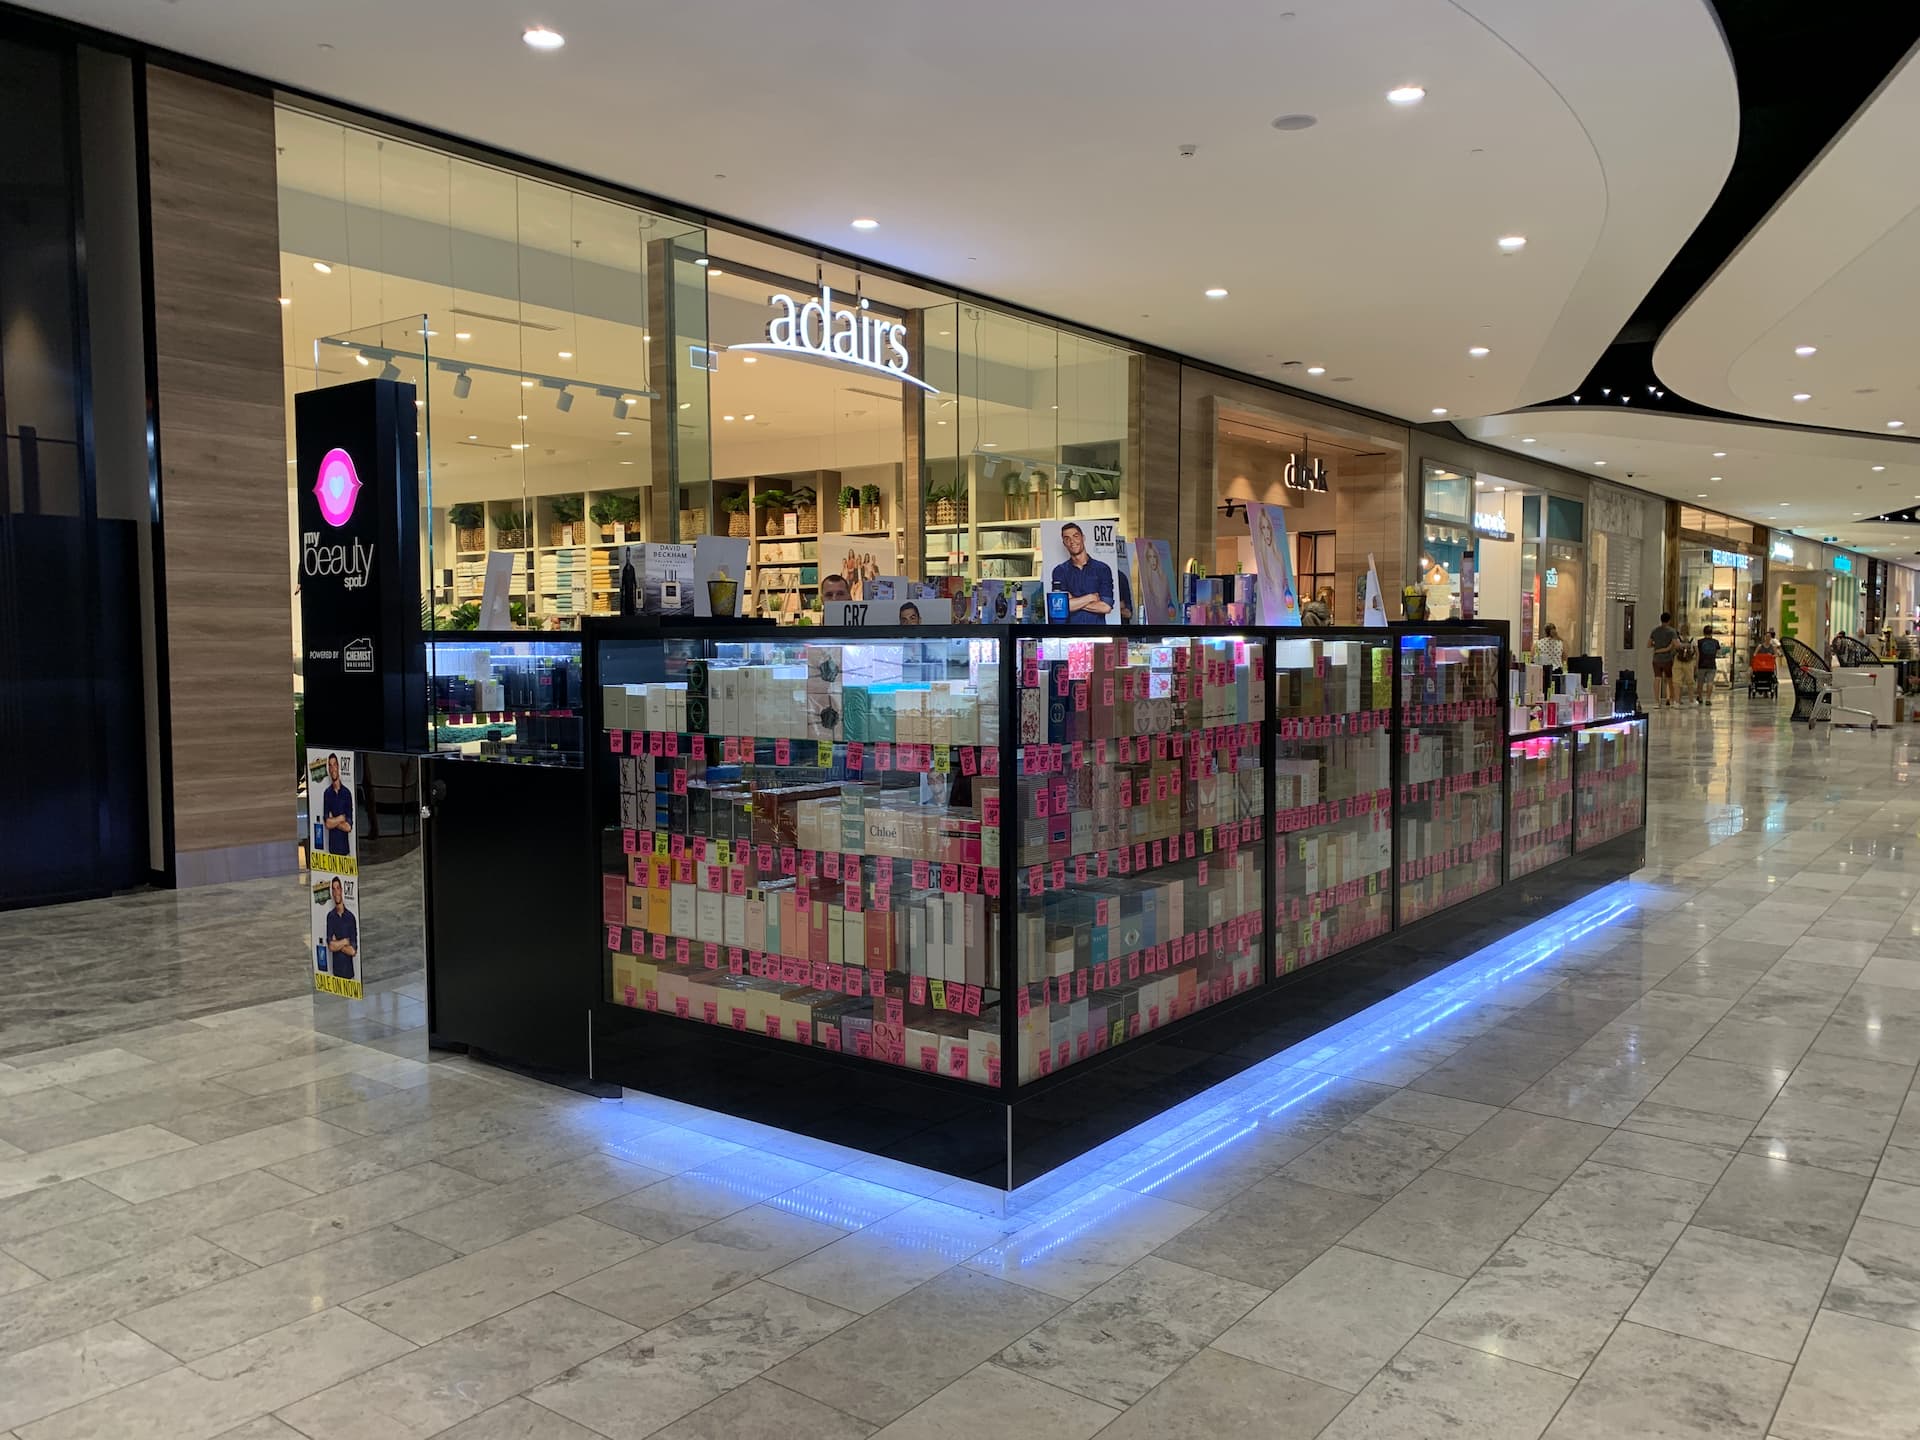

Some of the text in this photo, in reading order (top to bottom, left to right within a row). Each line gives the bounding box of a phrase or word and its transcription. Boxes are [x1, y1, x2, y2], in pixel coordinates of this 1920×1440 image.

[769, 286, 909, 372] adairs
[303, 532, 320, 547] my
[1094, 525, 1112, 541] CR7
[303, 536, 374, 587] beauty
[344, 574, 362, 590] spot
[843, 604, 868, 626] CR7
[309, 650, 339, 659] POWERED BY
[346, 650, 371, 661] CHEMIST
[311, 852, 327, 870] SALE
[328, 854, 337, 872] ON
[315, 973, 332, 992] SALE
[332, 977, 342, 994] ON
